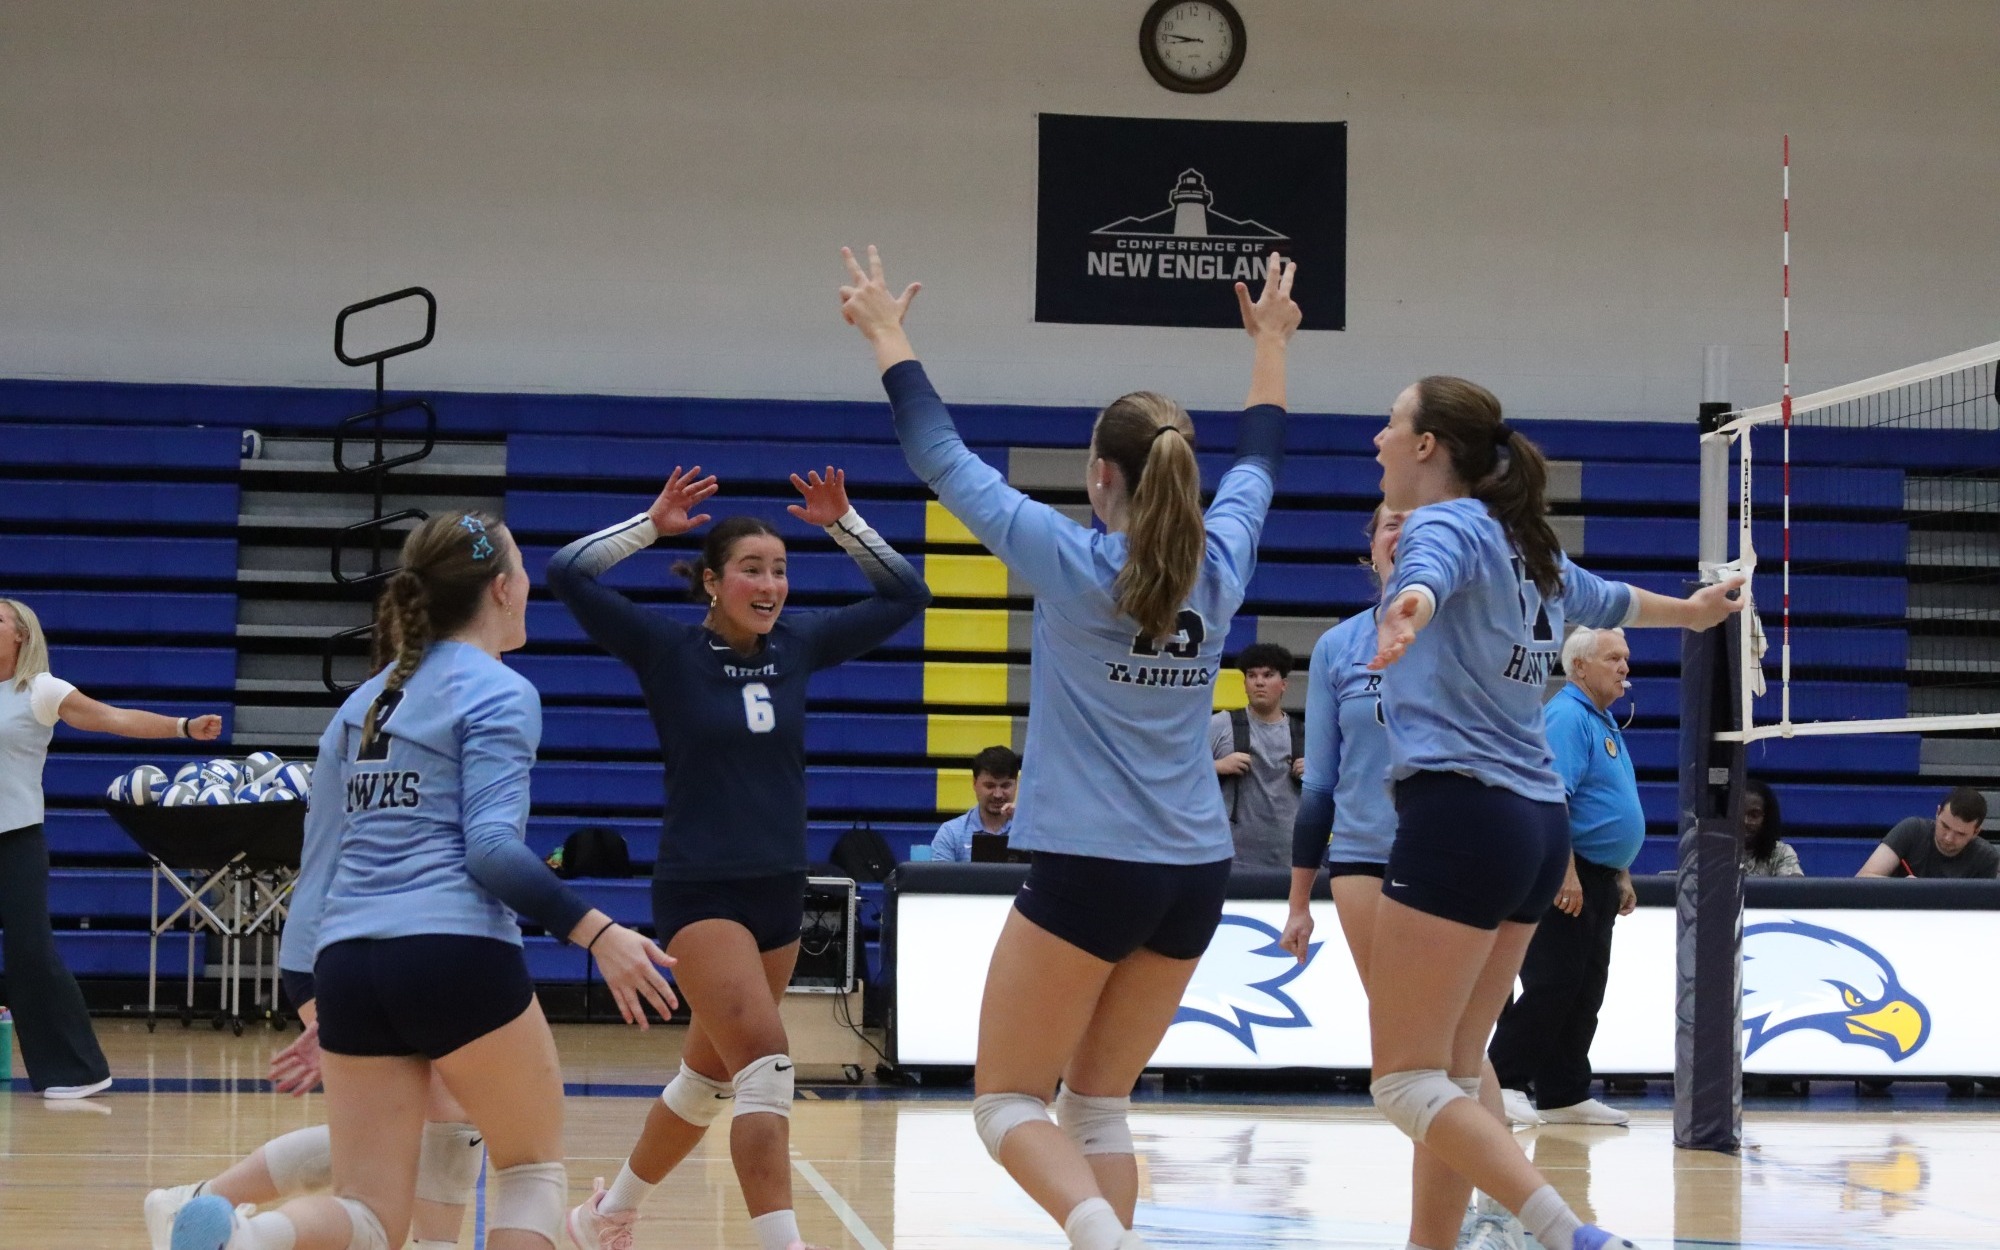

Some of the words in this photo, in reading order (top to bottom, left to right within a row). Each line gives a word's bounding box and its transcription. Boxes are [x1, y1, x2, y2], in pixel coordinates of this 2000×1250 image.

[1189, 6, 1199, 17] 12
[1164, 21, 1174, 31] 10
[1116, 239, 1236, 252] CONFERENCE
[1242, 243, 1265, 252] OF
[1087, 251, 1152, 278] NEW
[741, 682, 776, 734] 6
[355, 687, 406, 763] 2
